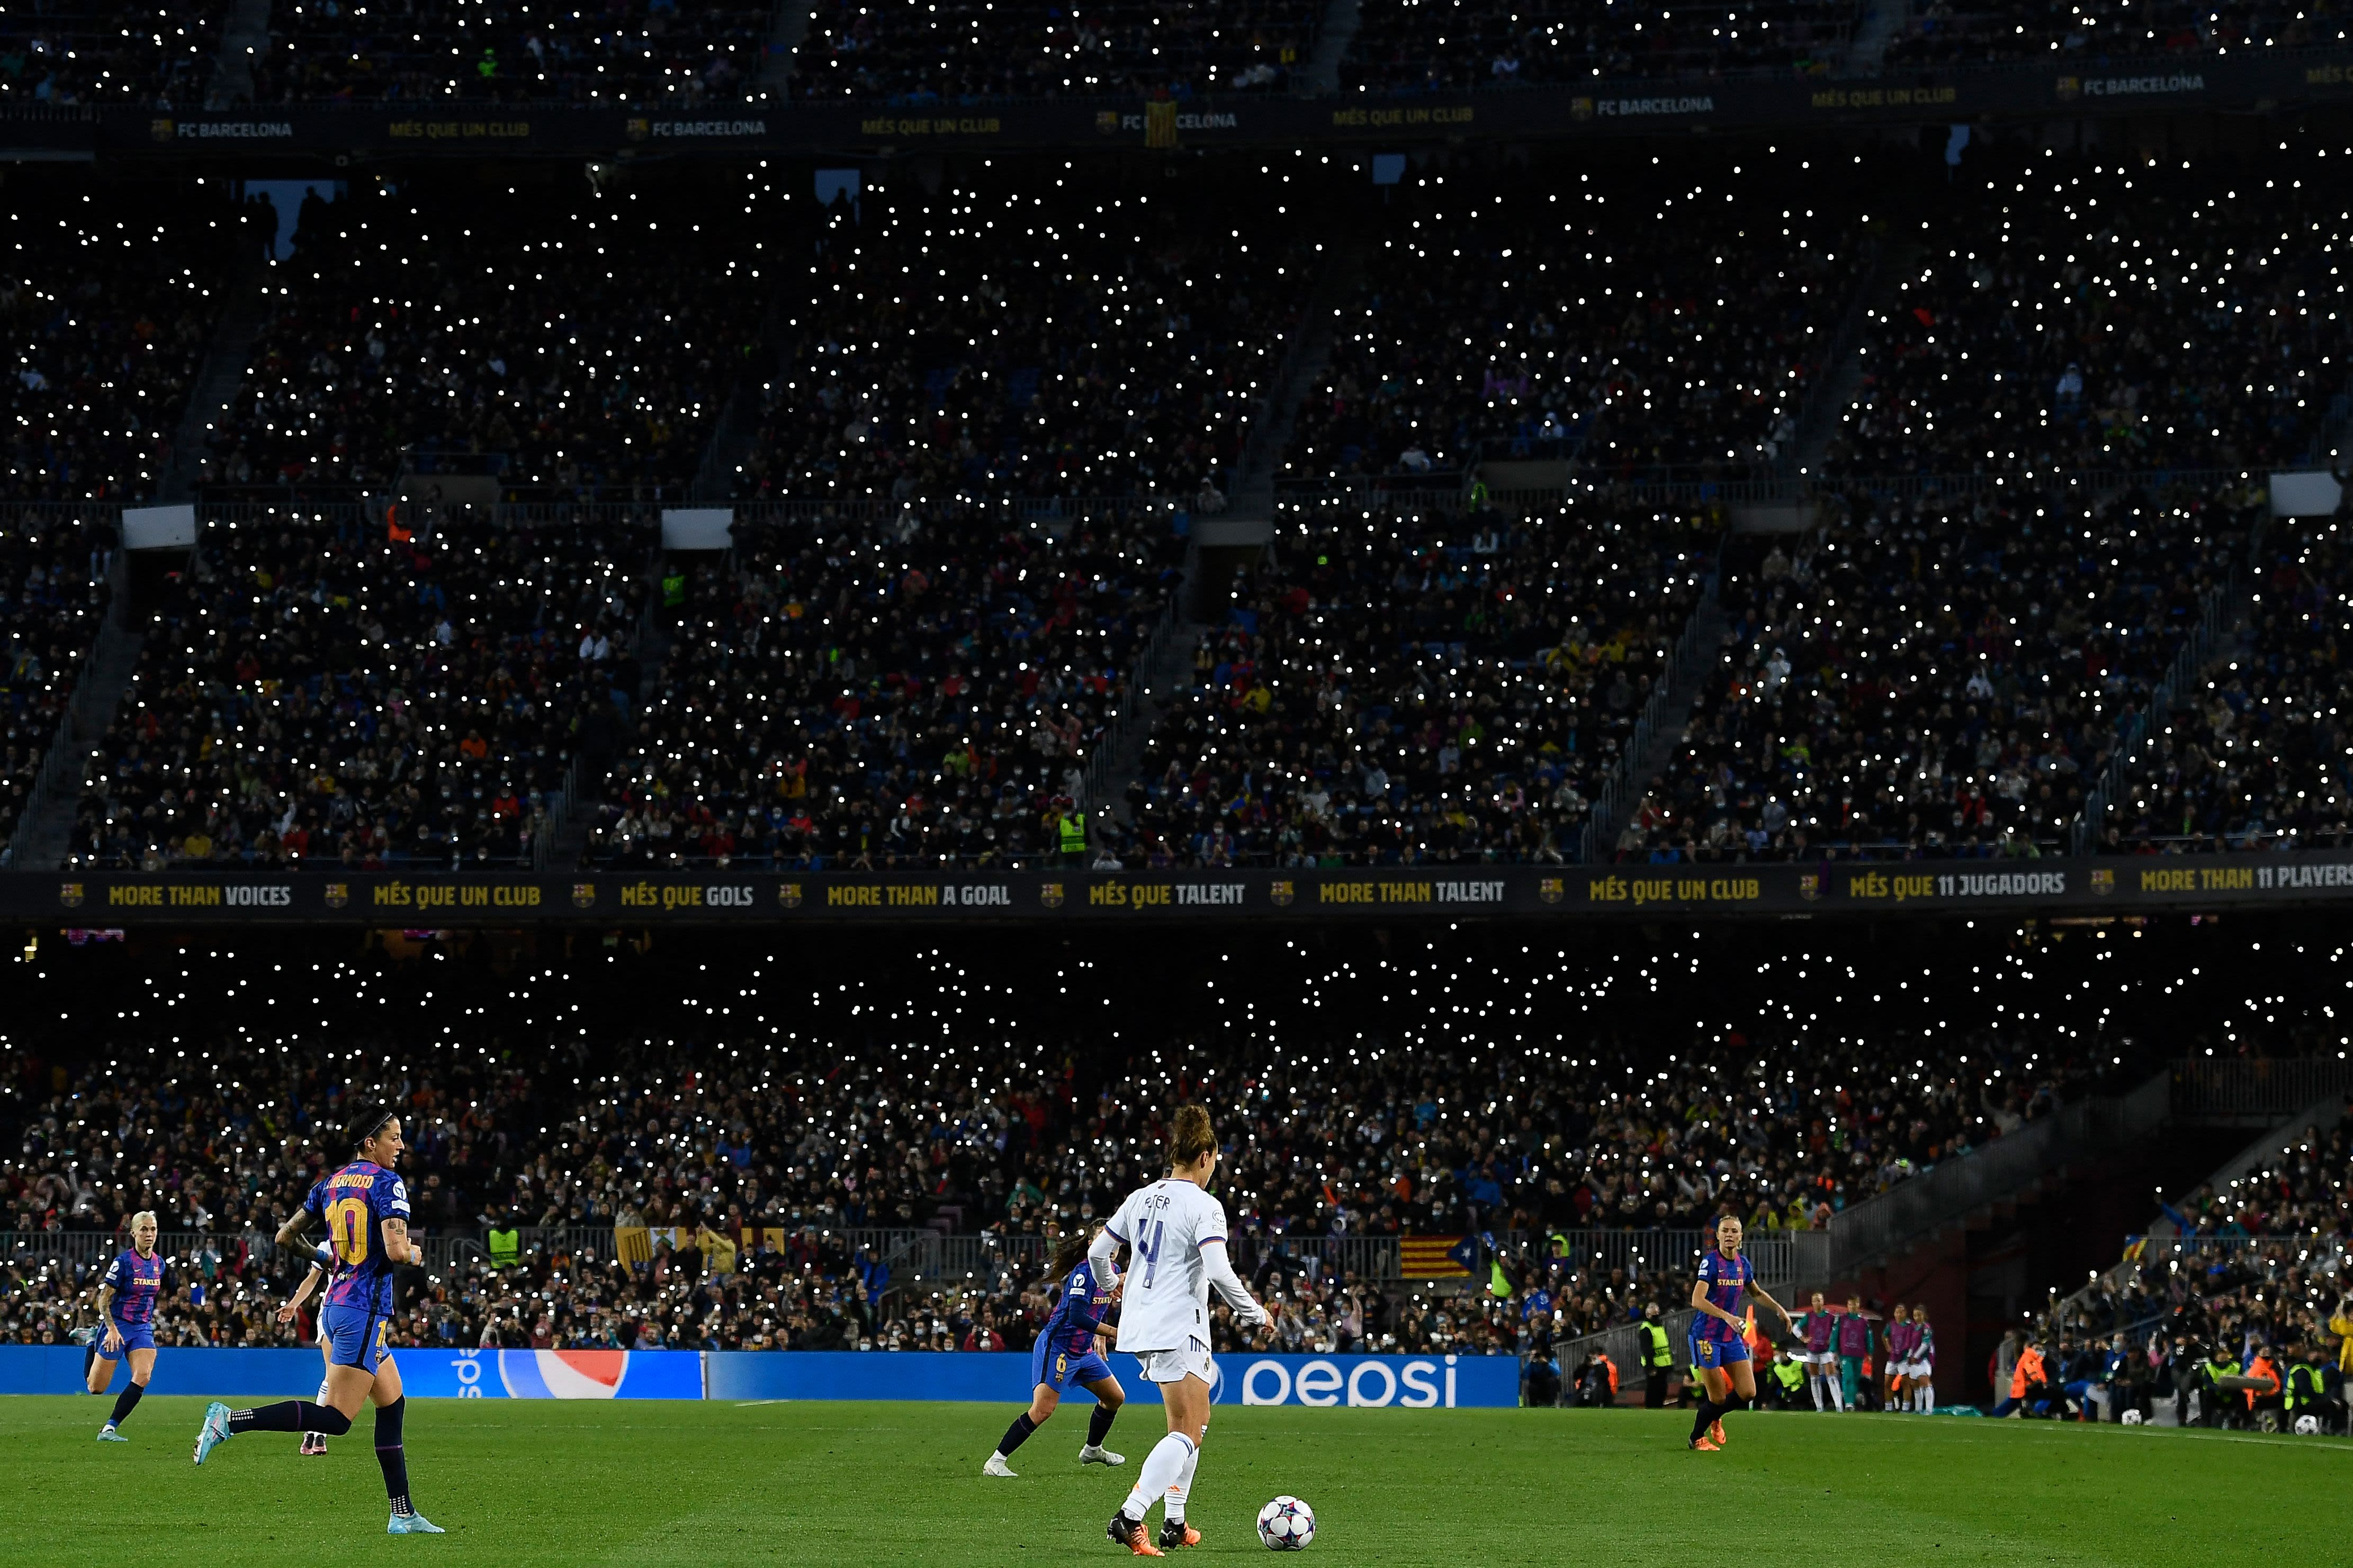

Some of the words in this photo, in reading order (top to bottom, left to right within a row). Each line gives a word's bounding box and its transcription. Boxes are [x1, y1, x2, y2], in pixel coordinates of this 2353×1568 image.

[2306, 65, 2342, 83] MÉS
[2083, 79, 2104, 95] FC
[2106, 75, 2204, 94] BARCELONA
[1597, 100, 1616, 115] FC
[1619, 96, 1713, 115] BARCELONA
[1811, 89, 1847, 107] MÉS
[1849, 89, 1883, 108] QUE
[1887, 89, 1911, 104] UN
[1914, 87, 1956, 104] CLUB
[861, 116, 895, 134] MÉS
[898, 119, 930, 136] QUE
[933, 119, 957, 133] UN
[959, 118, 1000, 133] CLUB
[1122, 115, 1141, 130] FC
[1333, 107, 1368, 125] MÉS
[1370, 109, 1403, 127] QUE
[1406, 109, 1430, 123] UN
[1432, 106, 1474, 123] CLUB
[178, 123, 196, 138] FC
[199, 123, 292, 138] BARCELONA
[389, 120, 424, 137] MÉS
[426, 122, 459, 139] QUE
[462, 123, 486, 137] UN
[488, 122, 529, 137] CLUB
[652, 122, 671, 137] FC
[673, 120, 766, 136] BARCELONA
[1850, 871, 1888, 897] MÉS
[1893, 876, 1934, 902] QUE
[1938, 876, 1954, 896] 11
[1959, 872, 2065, 896] JUGADORS
[2141, 869, 2195, 891] MORE
[2201, 868, 2252, 890] THAN
[2257, 867, 2273, 888] 11
[109, 886, 163, 905] MORE
[168, 886, 220, 905] THAN
[225, 886, 291, 906] VOICES
[374, 881, 411, 905] MÉS
[416, 886, 456, 910] QUE
[461, 886, 488, 906] UN
[493, 886, 541, 906] CLUB
[621, 881, 658, 906] MÉS
[663, 886, 702, 911] QUE
[706, 886, 753, 906] GOLS
[828, 886, 882, 906] MORE
[886, 886, 937, 905] THAN
[942, 886, 956, 905] A
[961, 885, 1011, 905] GOAL
[1090, 880, 1127, 905] MÉS
[1131, 885, 1171, 910] QUE
[1175, 884, 1245, 905] TALENT
[1320, 882, 1374, 903] MORE
[1379, 882, 1431, 902] THAN
[1435, 881, 1504, 902] TALENT
[1590, 875, 1627, 901] MÉS
[1632, 880, 1672, 905] QUE
[1677, 880, 1706, 900] UN
[1711, 879, 1759, 900] CLUB
[325, 1197, 369, 1266] 10
[1137, 1218, 1164, 1290] 4
[1056, 1353, 1067, 1373] 6
[1242, 1354, 1458, 1408] pepsi
